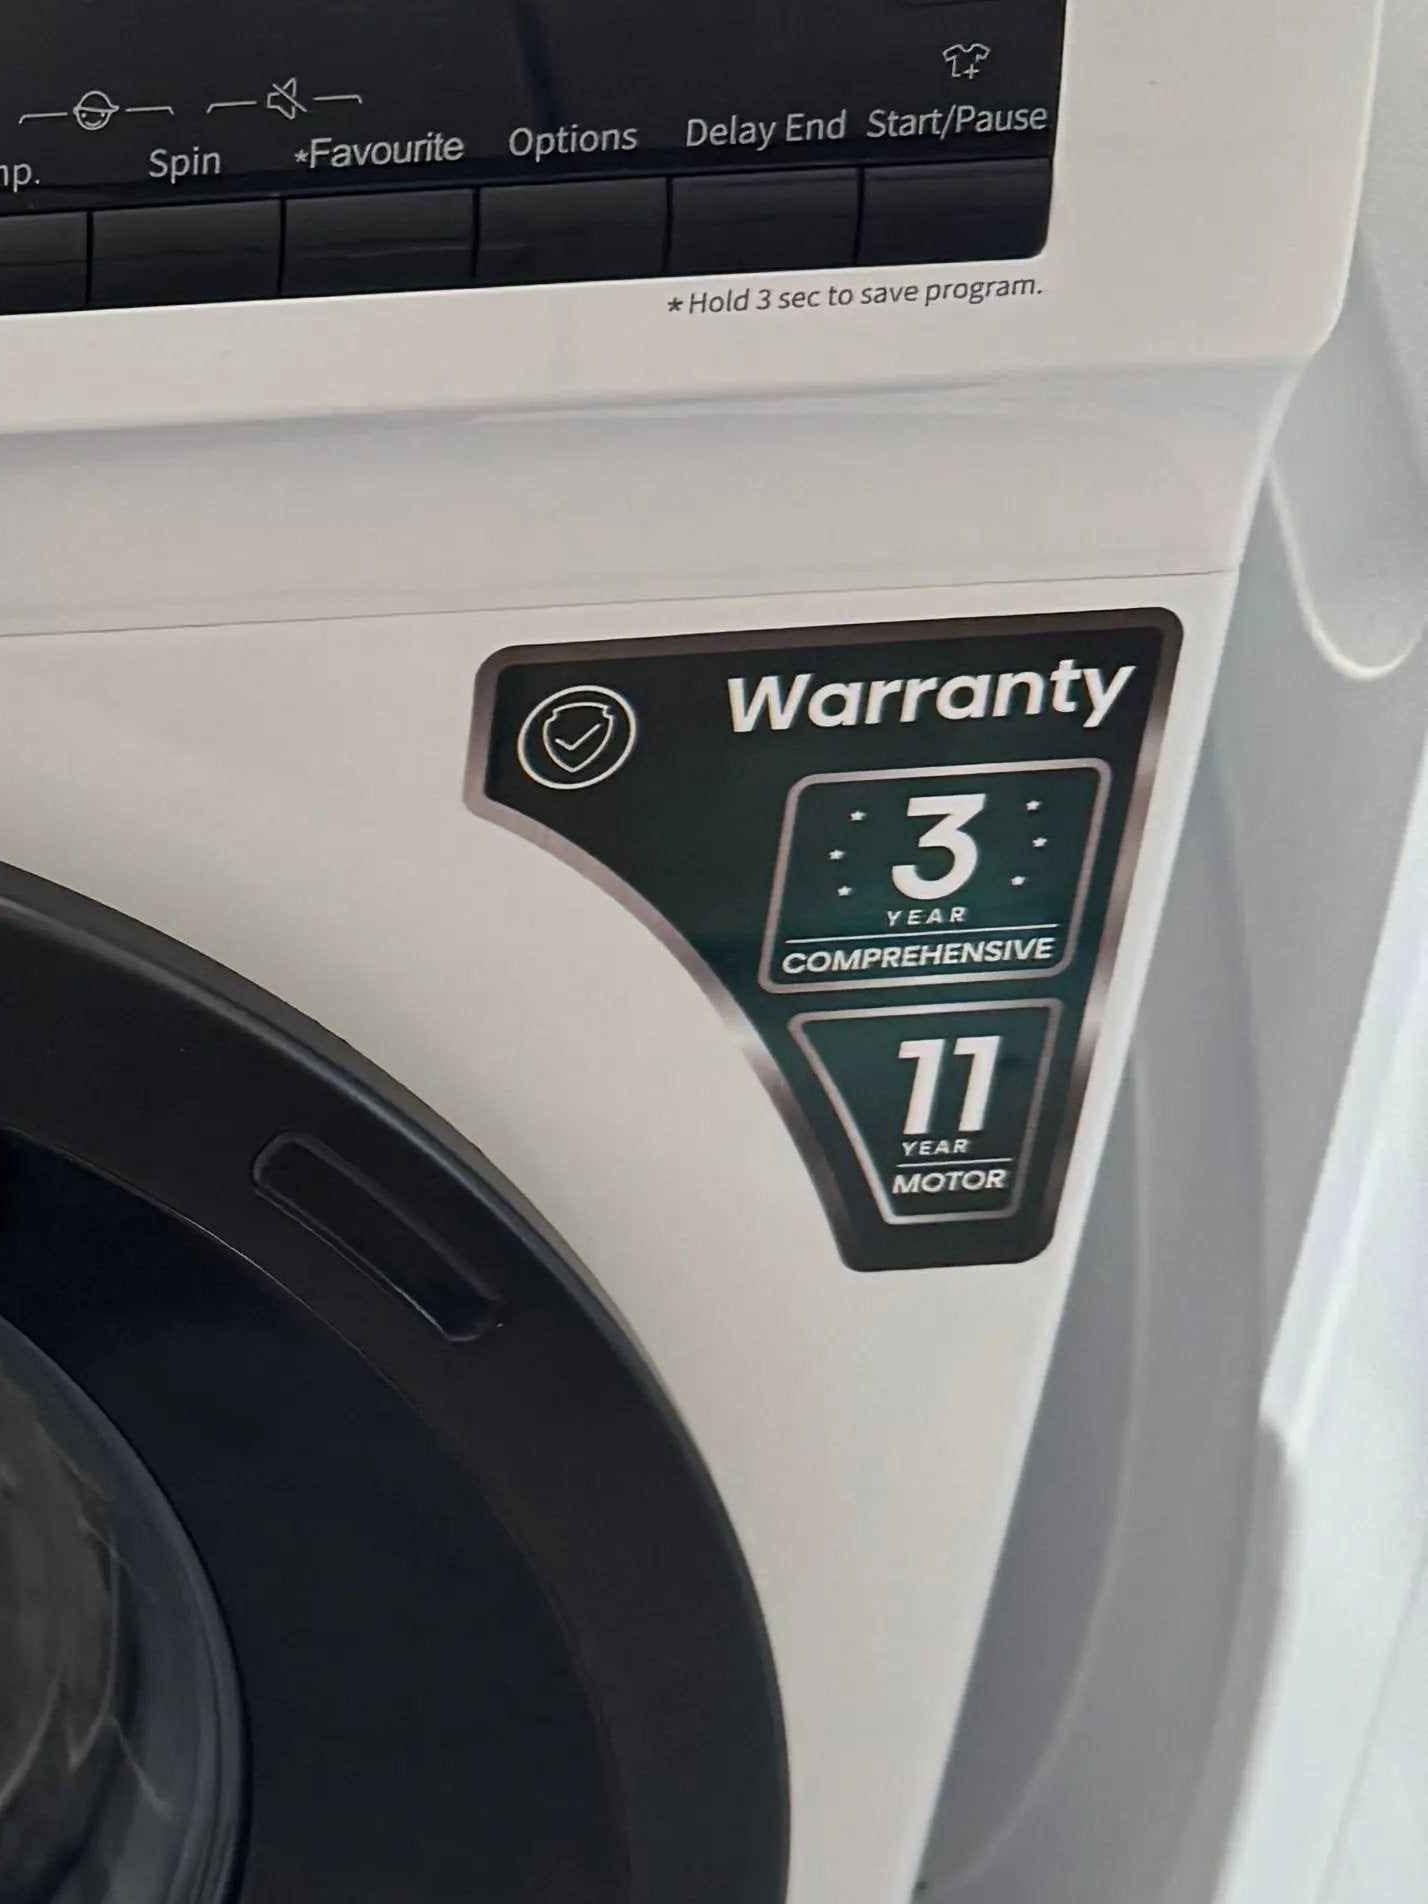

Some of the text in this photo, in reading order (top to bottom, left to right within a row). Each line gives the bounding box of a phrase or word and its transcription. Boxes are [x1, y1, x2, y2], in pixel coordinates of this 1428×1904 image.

[687, 109, 846, 151] Delay End
[867, 104, 1047, 139] Start/Pause
[509, 124, 637, 162] Options
[149, 146, 220, 184] Spin
[756, 289, 771, 310] 3
[778, 291, 820, 309] sec
[829, 286, 853, 306] to
[861, 286, 919, 304] save
[925, 279, 1042, 307] program.
[728, 659, 1136, 732] Warranty
[892, 794, 986, 899] 3
[887, 907, 966, 926] YEAR
[782, 937, 1054, 976] COMPREHENSIVE
[899, 1036, 1001, 1134] 11
[902, 1139, 970, 1156] YEAR
[892, 1169, 1007, 1193] MOTOR
